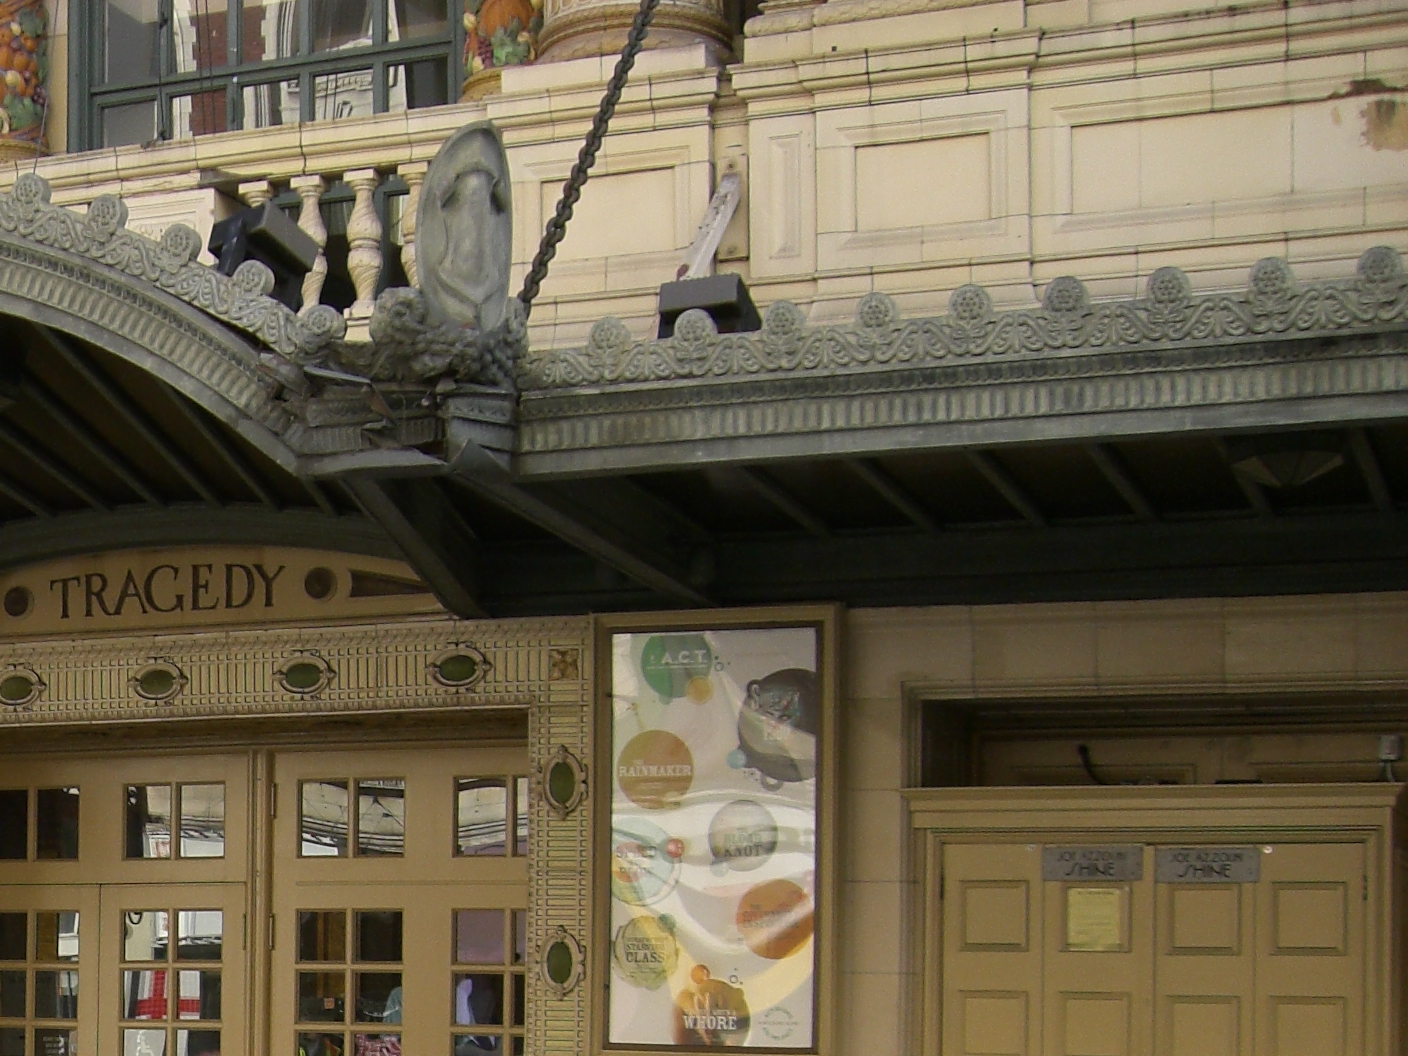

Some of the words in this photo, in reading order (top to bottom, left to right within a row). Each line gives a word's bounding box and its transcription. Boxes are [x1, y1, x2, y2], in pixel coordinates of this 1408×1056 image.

[50, 564, 286, 619] TRAGEDY
[661, 651, 708, 664] A.C.T.
[618, 764, 692, 777] RAINMAKER
[723, 845, 763, 857] KNOT
[1064, 862, 1115, 876] SHINE
[1177, 863, 1231, 878] SHINE
[626, 952, 666, 963] CLASS
[683, 1015, 737, 1030] WHORE
